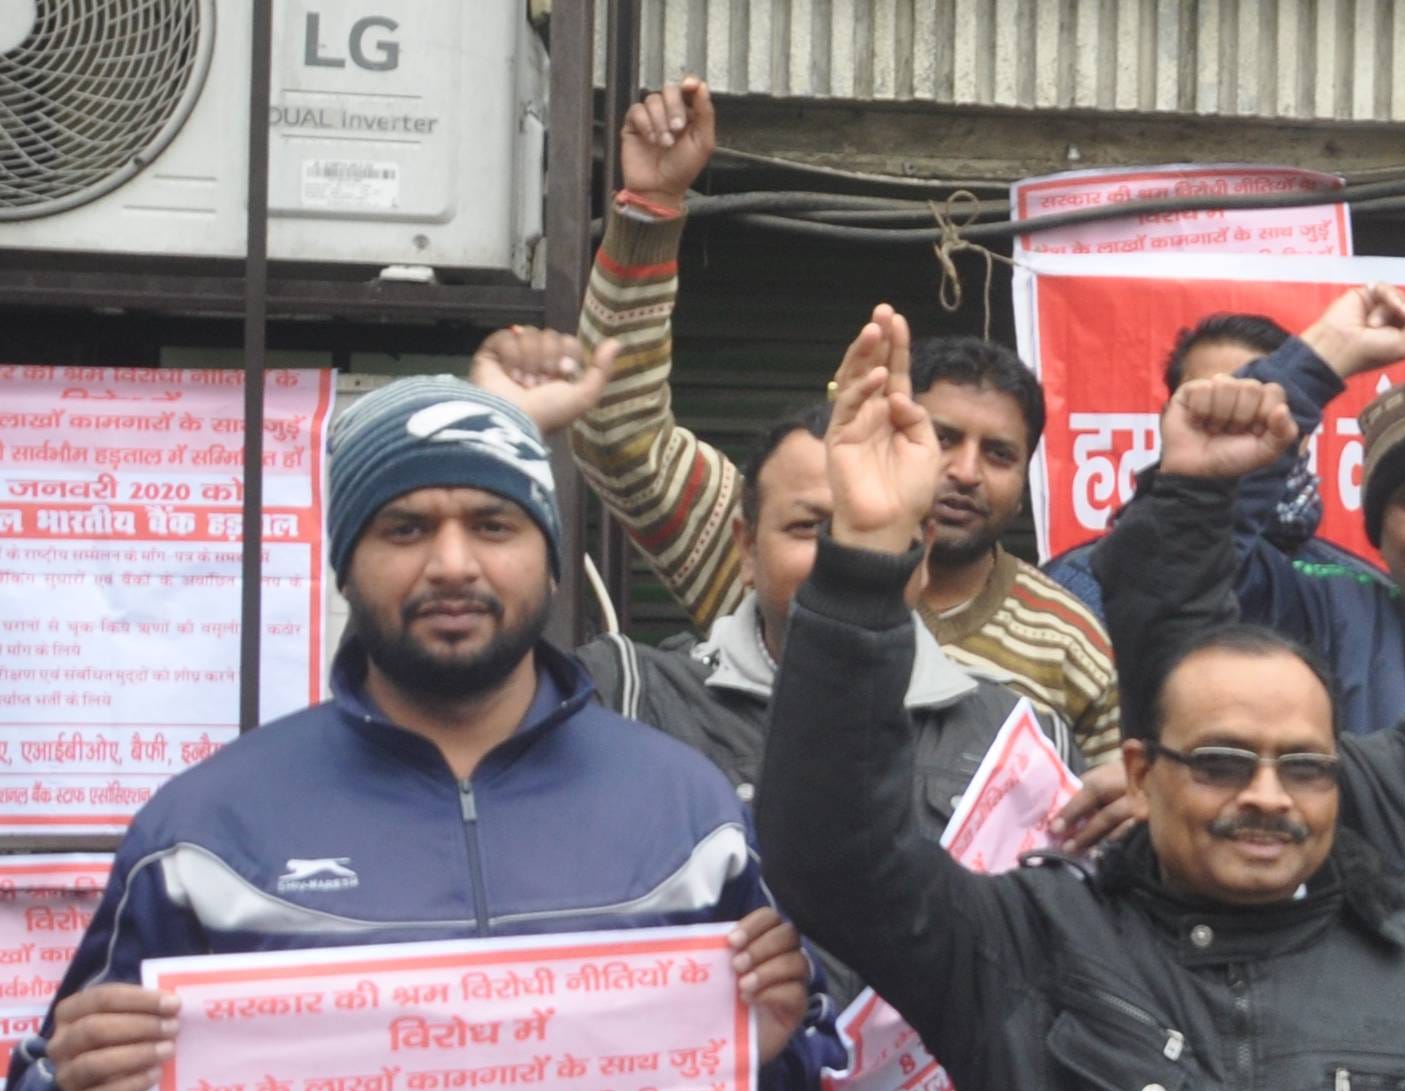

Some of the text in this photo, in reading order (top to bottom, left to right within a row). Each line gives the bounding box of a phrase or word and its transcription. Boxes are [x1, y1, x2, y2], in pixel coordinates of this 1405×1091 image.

[304, 11, 400, 72] LG
[1233, 226, 1252, 241] के
[70, 409, 202, 433] कामगारों के
[6, 472, 119, 500] जनवरी
[129, 481, 192, 501] 2020
[36, 502, 137, 535] भारतीय
[205, 992, 324, 1020] सरकार
[335, 980, 379, 1009] की
[460, 965, 554, 1000] विरोधी
[566, 960, 673, 992] नीतियों
[680, 959, 712, 985] के
[389, 1007, 555, 1052] विरोध में
[407, 1055, 551, 1091] कामगारों
[556, 1053, 591, 1079] के
[599, 1052, 661, 1077] साथ
[668, 1038, 726, 1078] जुड़ें
